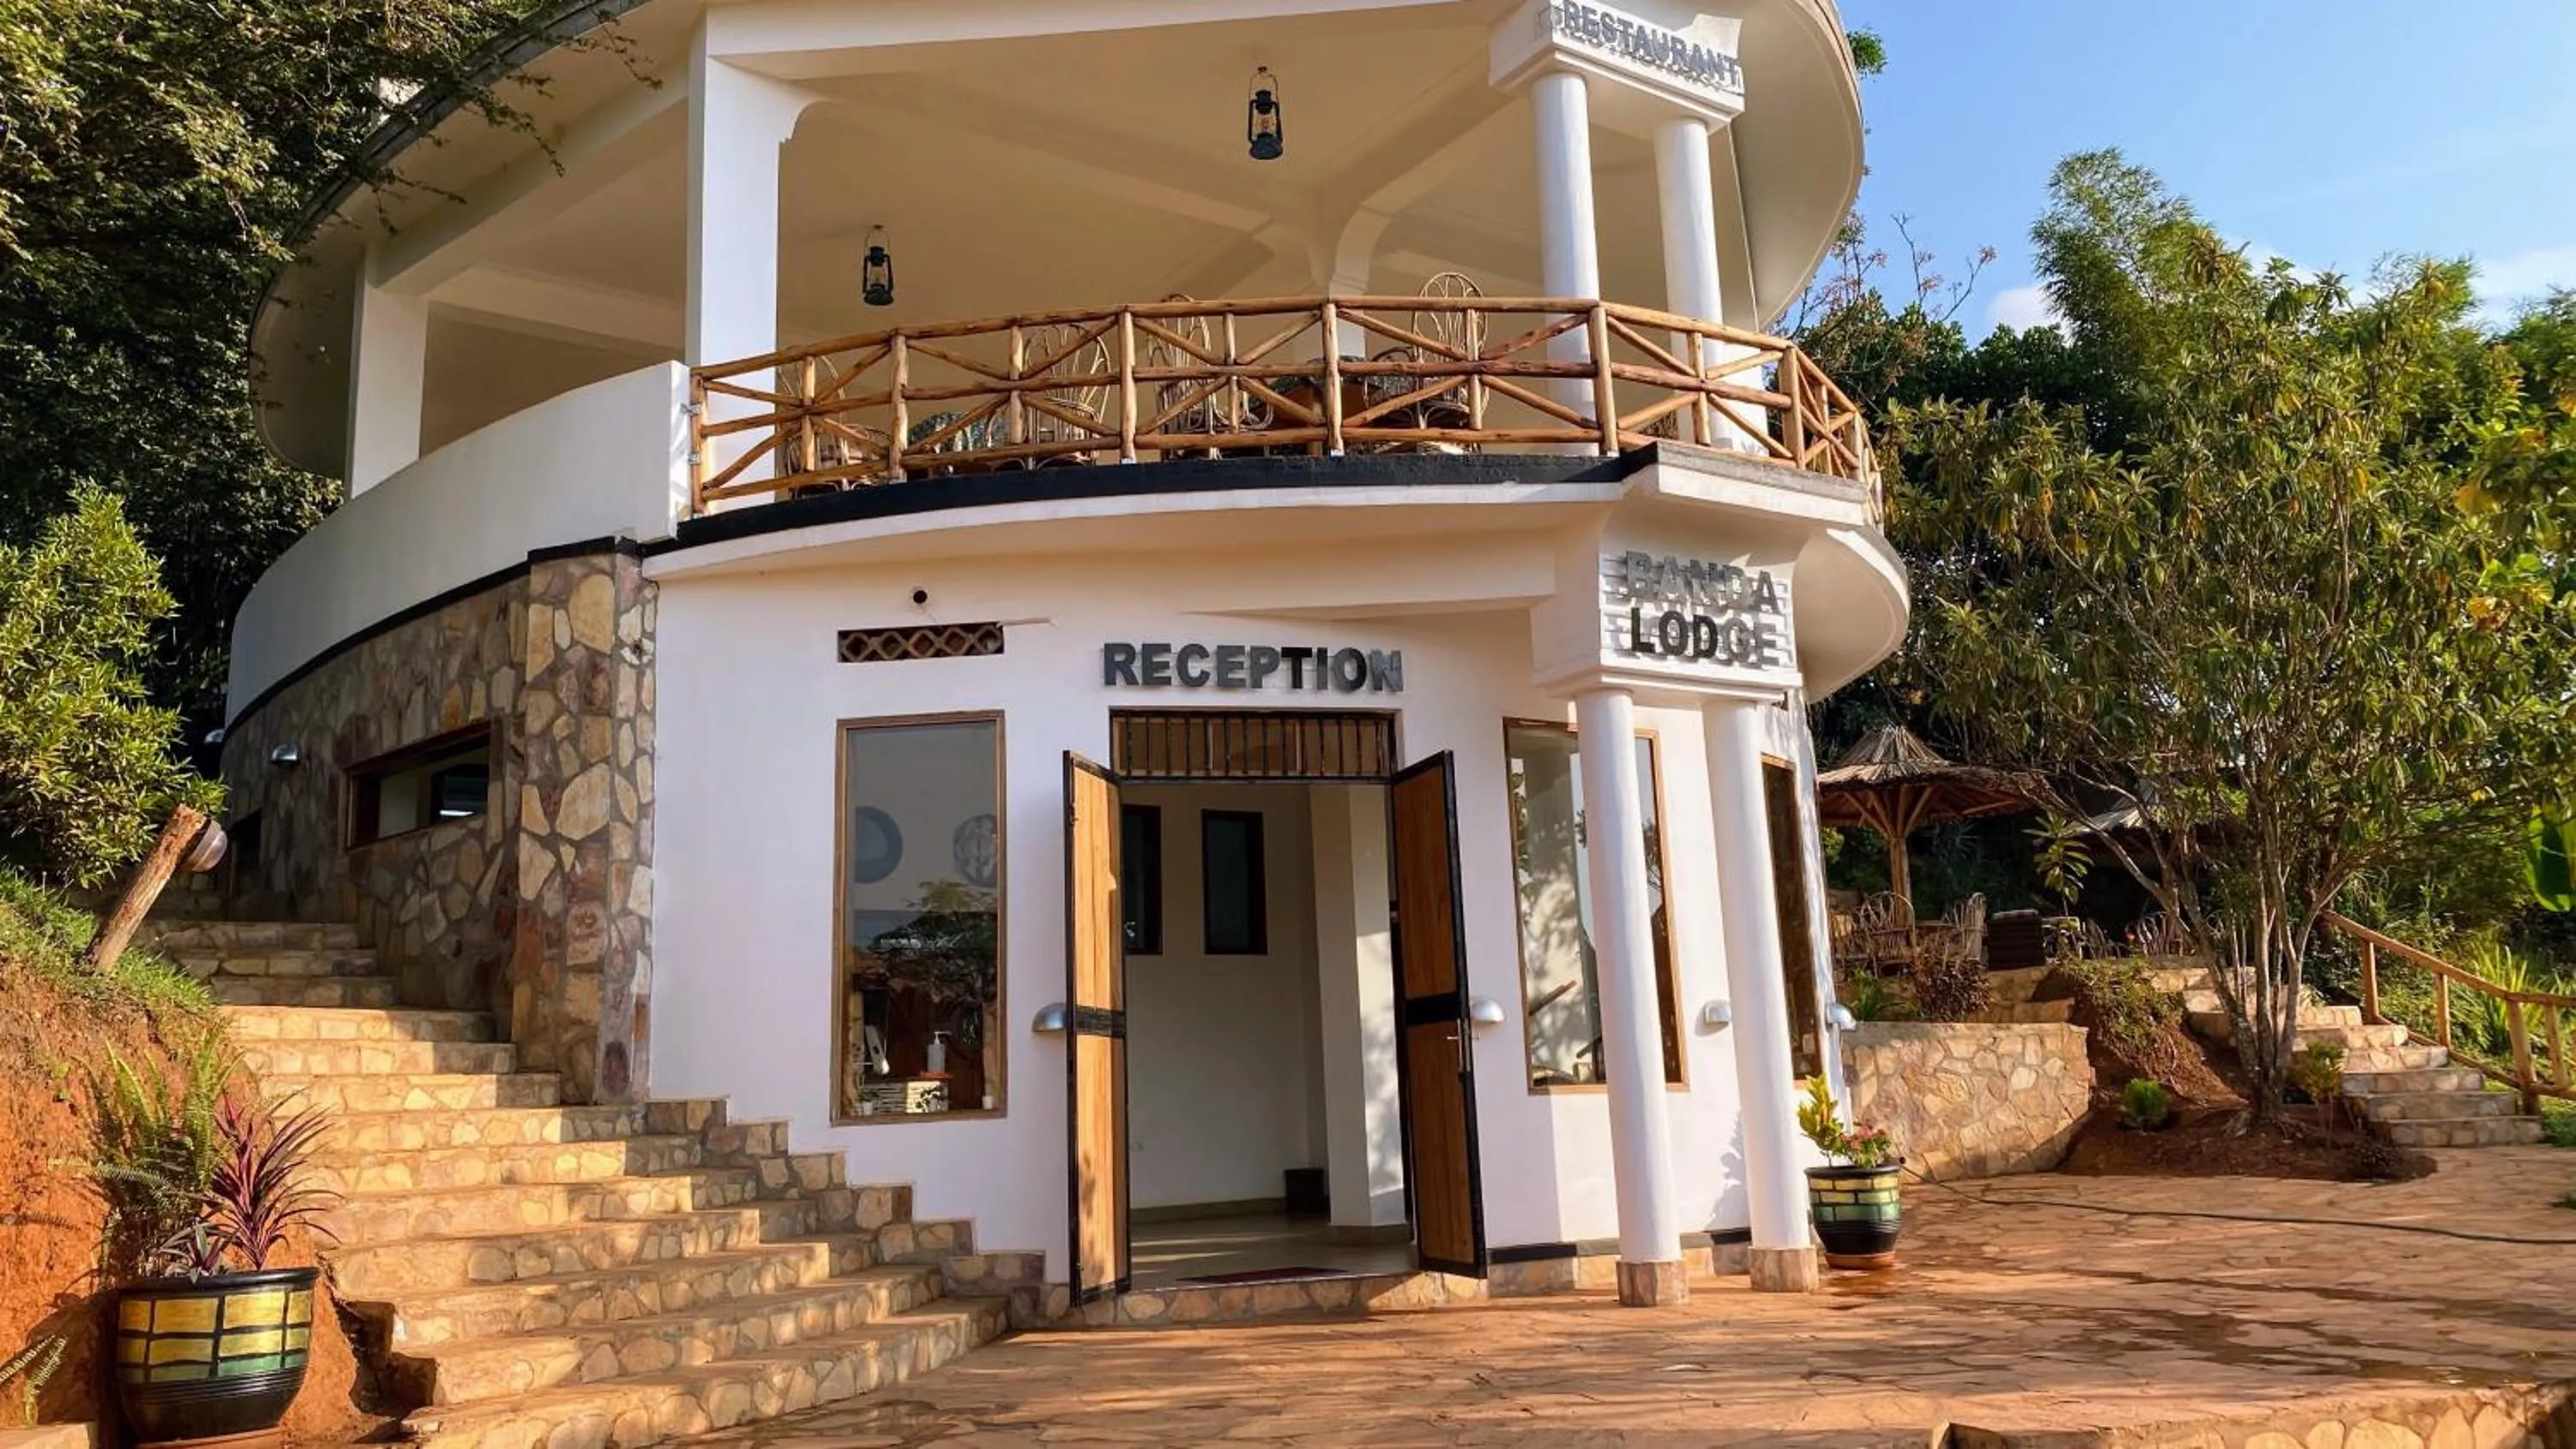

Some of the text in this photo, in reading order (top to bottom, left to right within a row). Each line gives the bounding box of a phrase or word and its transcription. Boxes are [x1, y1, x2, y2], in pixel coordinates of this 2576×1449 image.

[1563, 0, 1740, 87] RESTAURANT
[1626, 550, 1779, 614] BANDA
[1103, 643, 1403, 692] RECEPTION
[1631, 607, 1780, 668] LODGE
